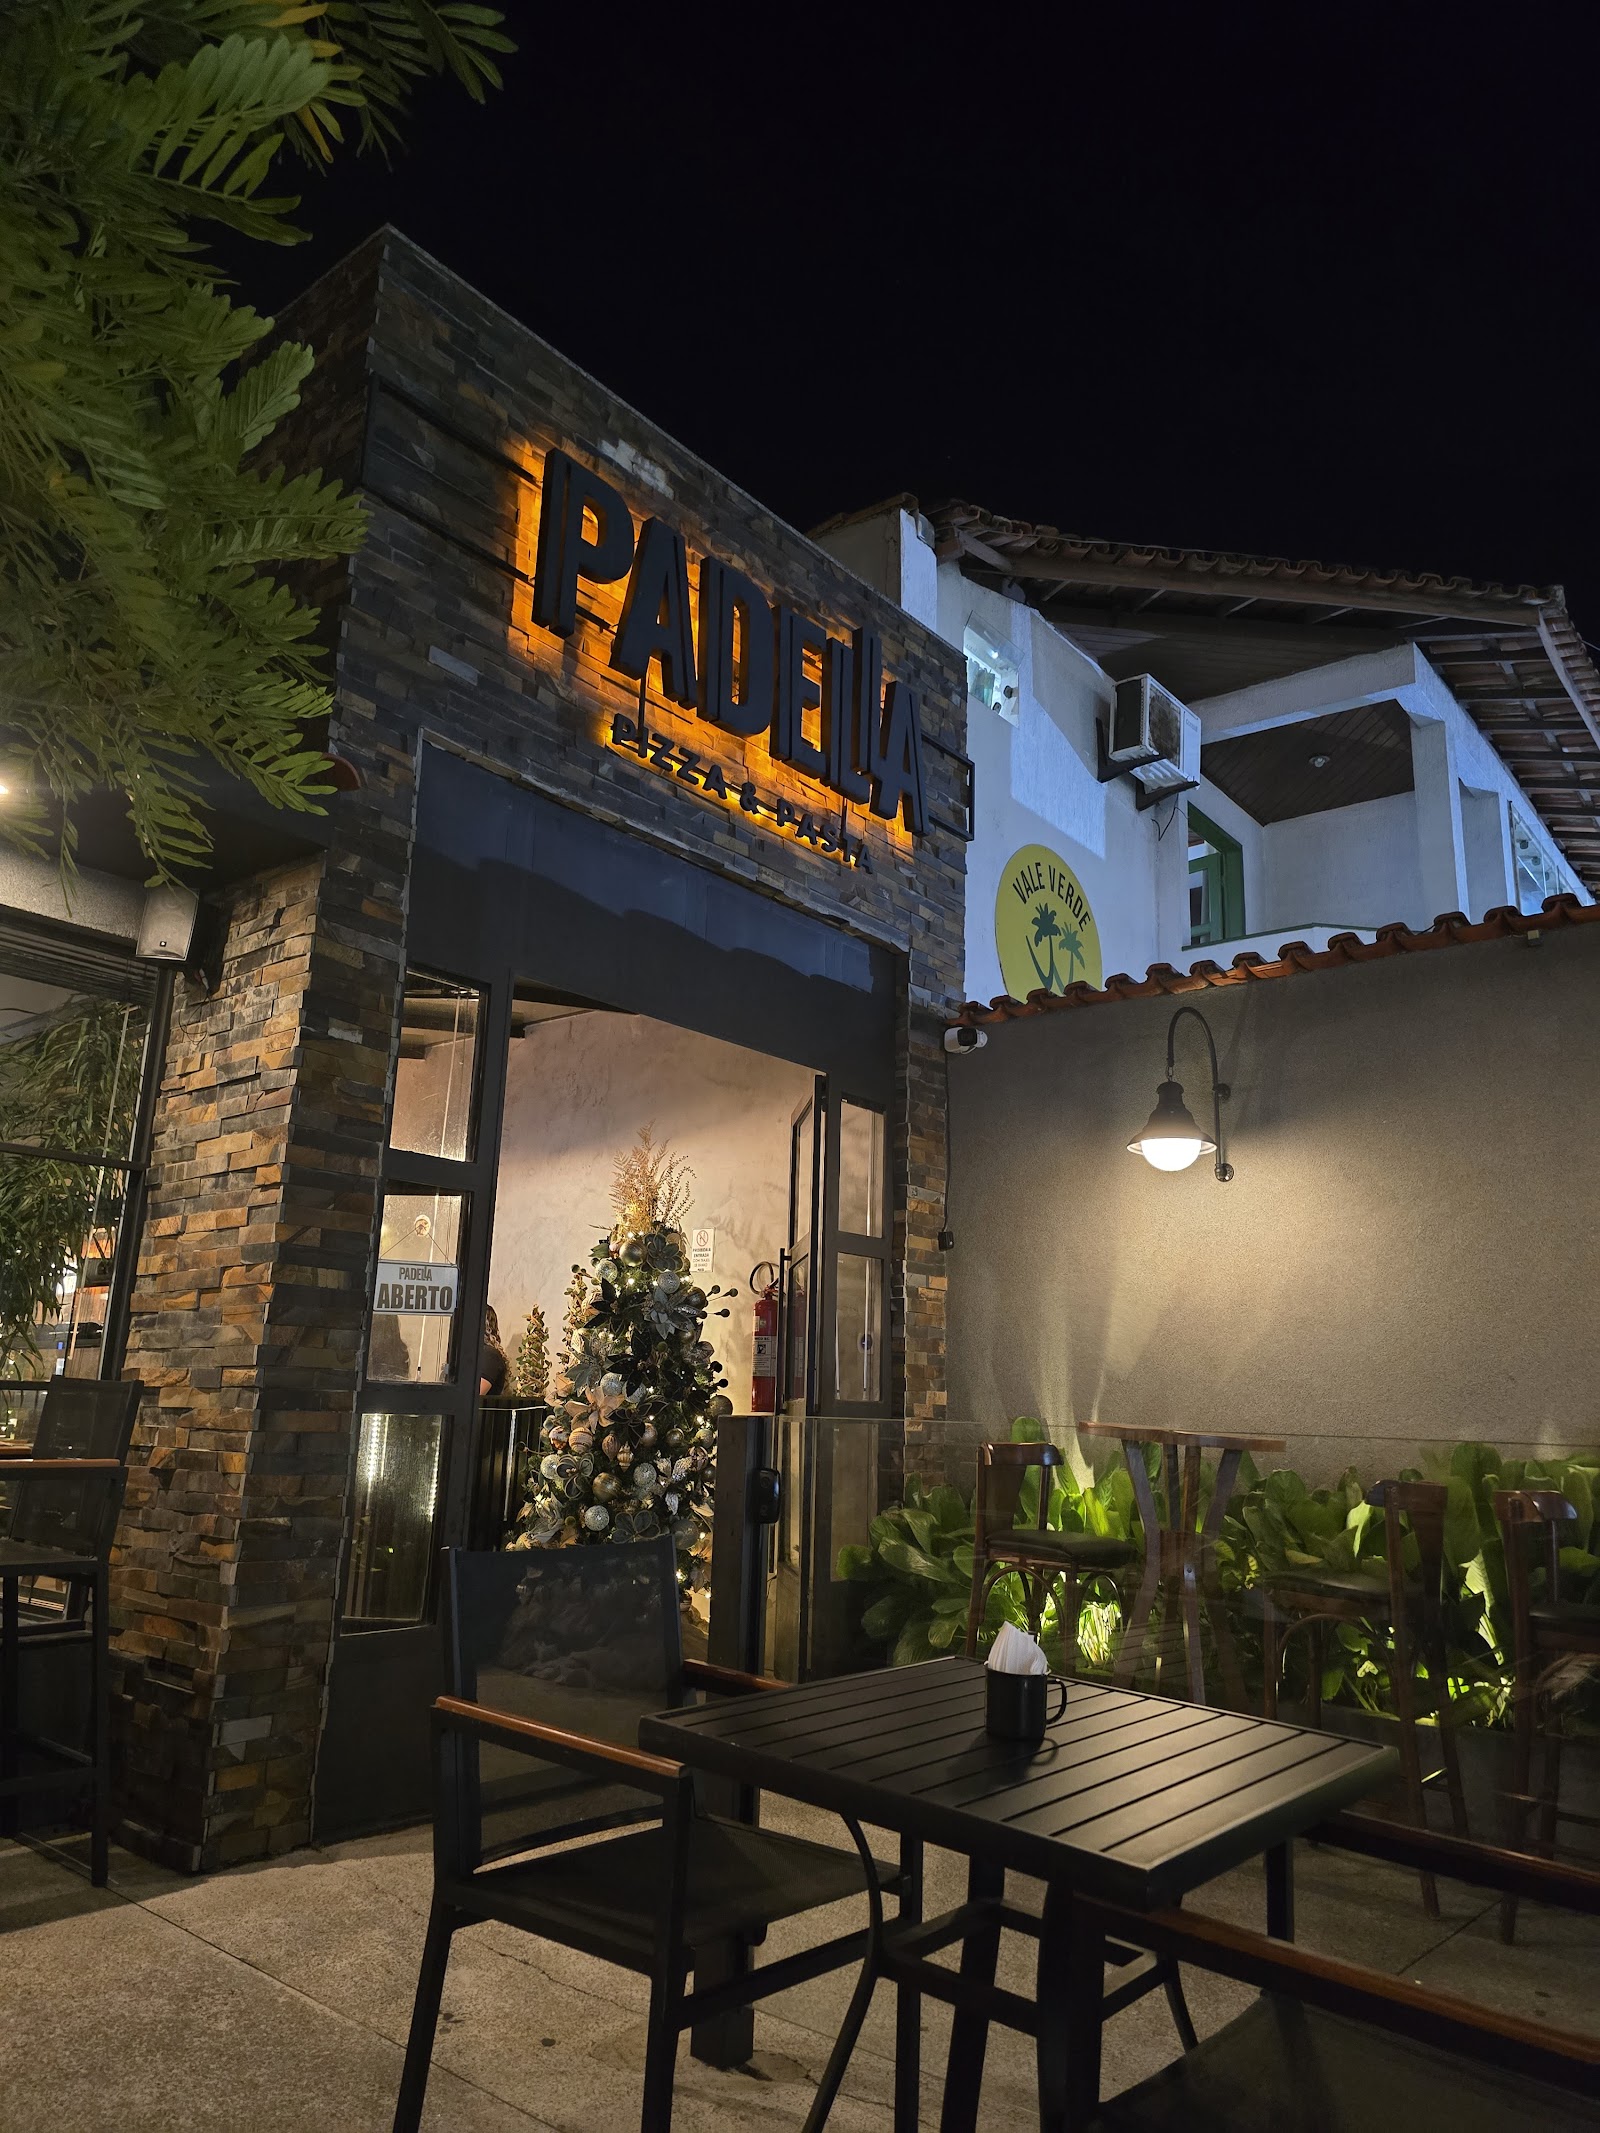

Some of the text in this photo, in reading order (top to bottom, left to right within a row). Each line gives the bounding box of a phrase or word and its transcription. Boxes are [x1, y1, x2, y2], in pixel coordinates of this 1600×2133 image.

[531, 447, 929, 838] PADELLA
[611, 713, 873, 875] PIZZA & PASTA
[1012, 862, 1091, 932] VALE VERDE
[377, 1283, 453, 1311] ABERTO
[399, 1266, 433, 1281] PADELLA
